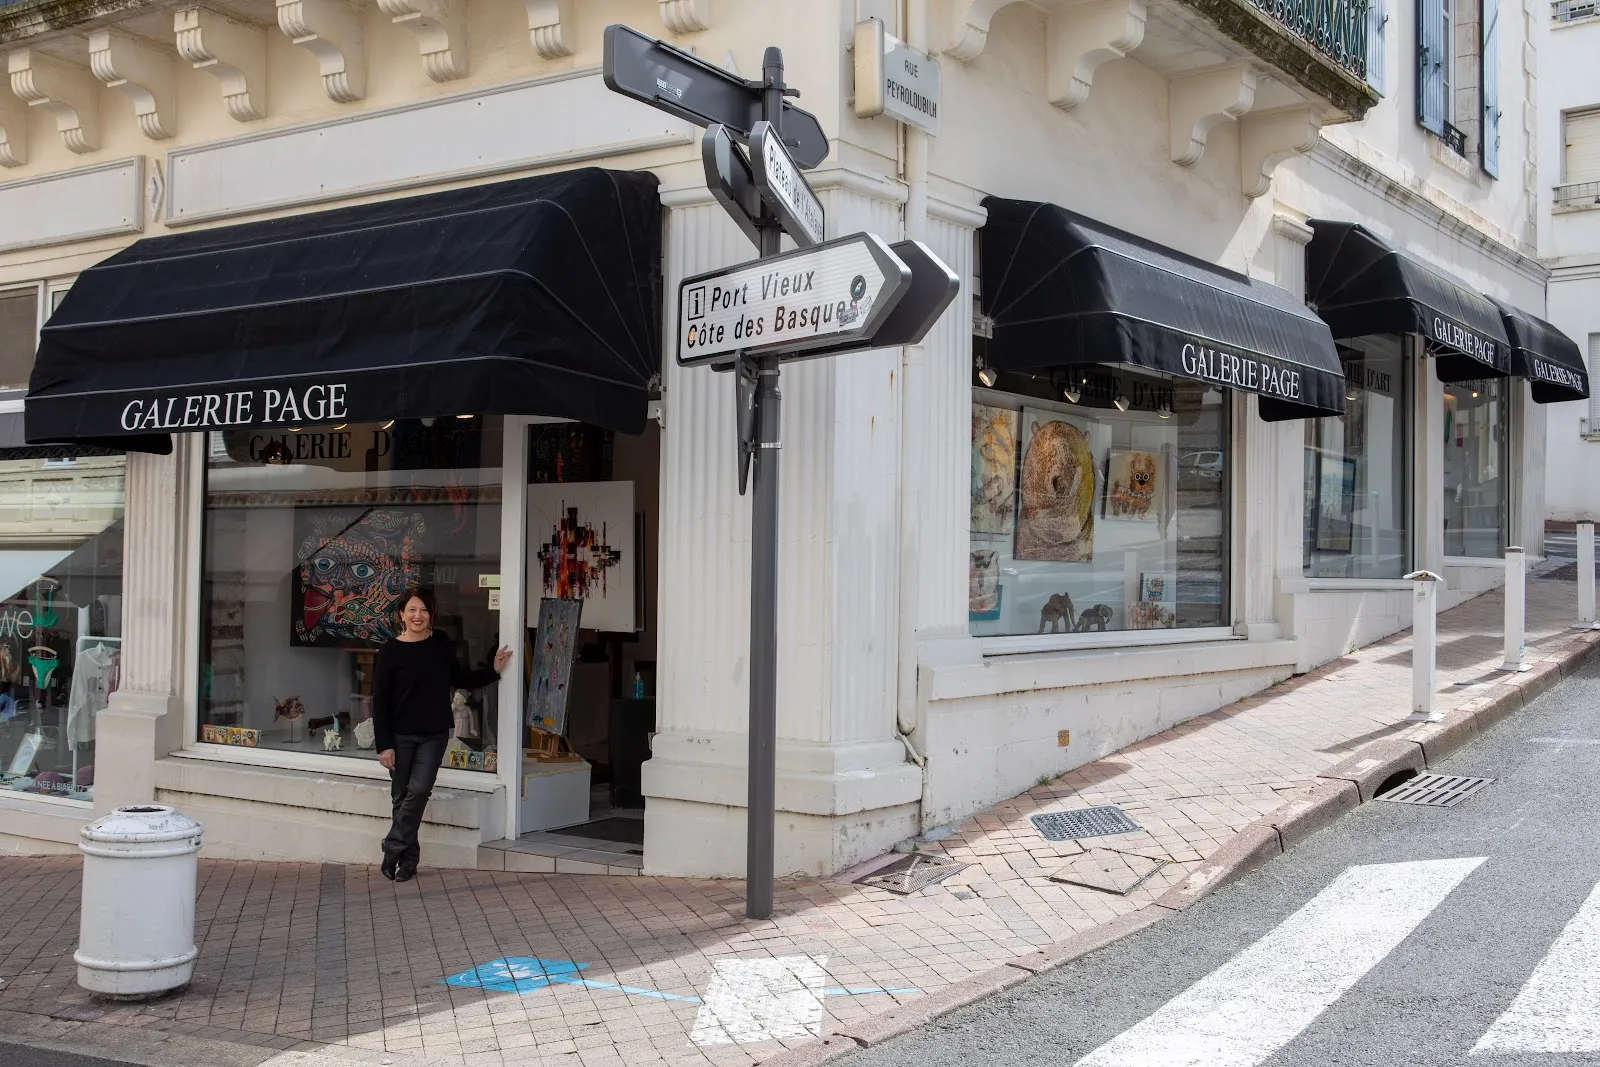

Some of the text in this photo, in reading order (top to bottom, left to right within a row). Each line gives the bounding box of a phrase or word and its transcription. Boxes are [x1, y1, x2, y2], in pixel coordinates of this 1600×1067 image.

[904, 59, 918, 78] RUE
[887, 78, 937, 119] PEYROLOUBILH
[769, 144, 792, 197] Plateau
[793, 182, 800, 210] de
[711, 282, 748, 312] Port
[761, 270, 815, 300] Vieux
[687, 322, 725, 348] Côte
[734, 313, 764, 340] des
[1434, 317, 1495, 364] GALERIE PAGE
[1182, 343, 1300, 399] GALERIE PAGE
[1366, 368, 1391, 393] D'ART
[1534, 359, 1584, 393] GALERIE PAGE
[120, 383, 348, 431] GALERIE PAGE
